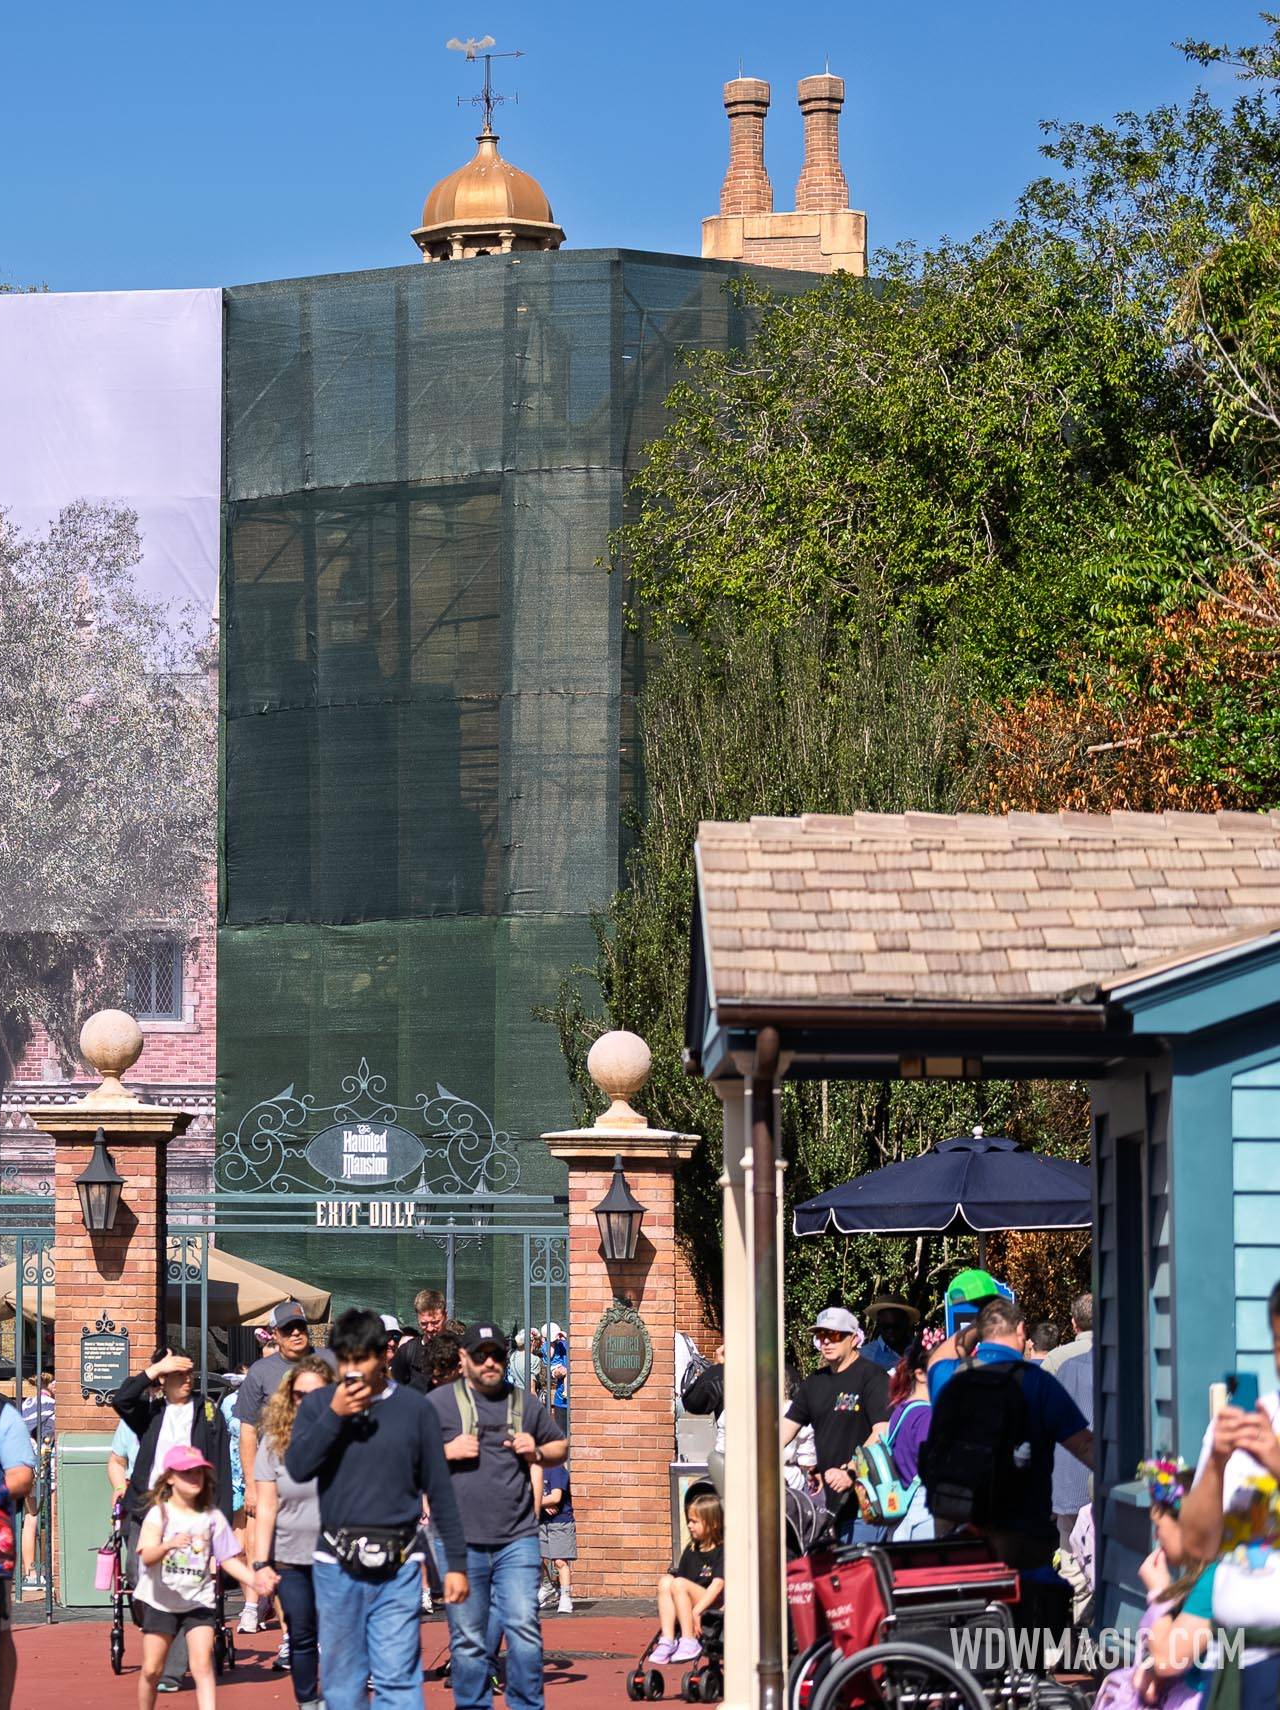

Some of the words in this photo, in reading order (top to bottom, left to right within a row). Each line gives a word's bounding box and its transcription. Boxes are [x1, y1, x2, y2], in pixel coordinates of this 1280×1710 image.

[343, 1129, 388, 1152] Haunted
[341, 1153, 388, 1179] Mansion
[316, 1201, 360, 1228] EXIT
[369, 1201, 415, 1228] ONLY
[606, 1335, 639, 1352] Haunted
[605, 1352, 640, 1371] Mansion
